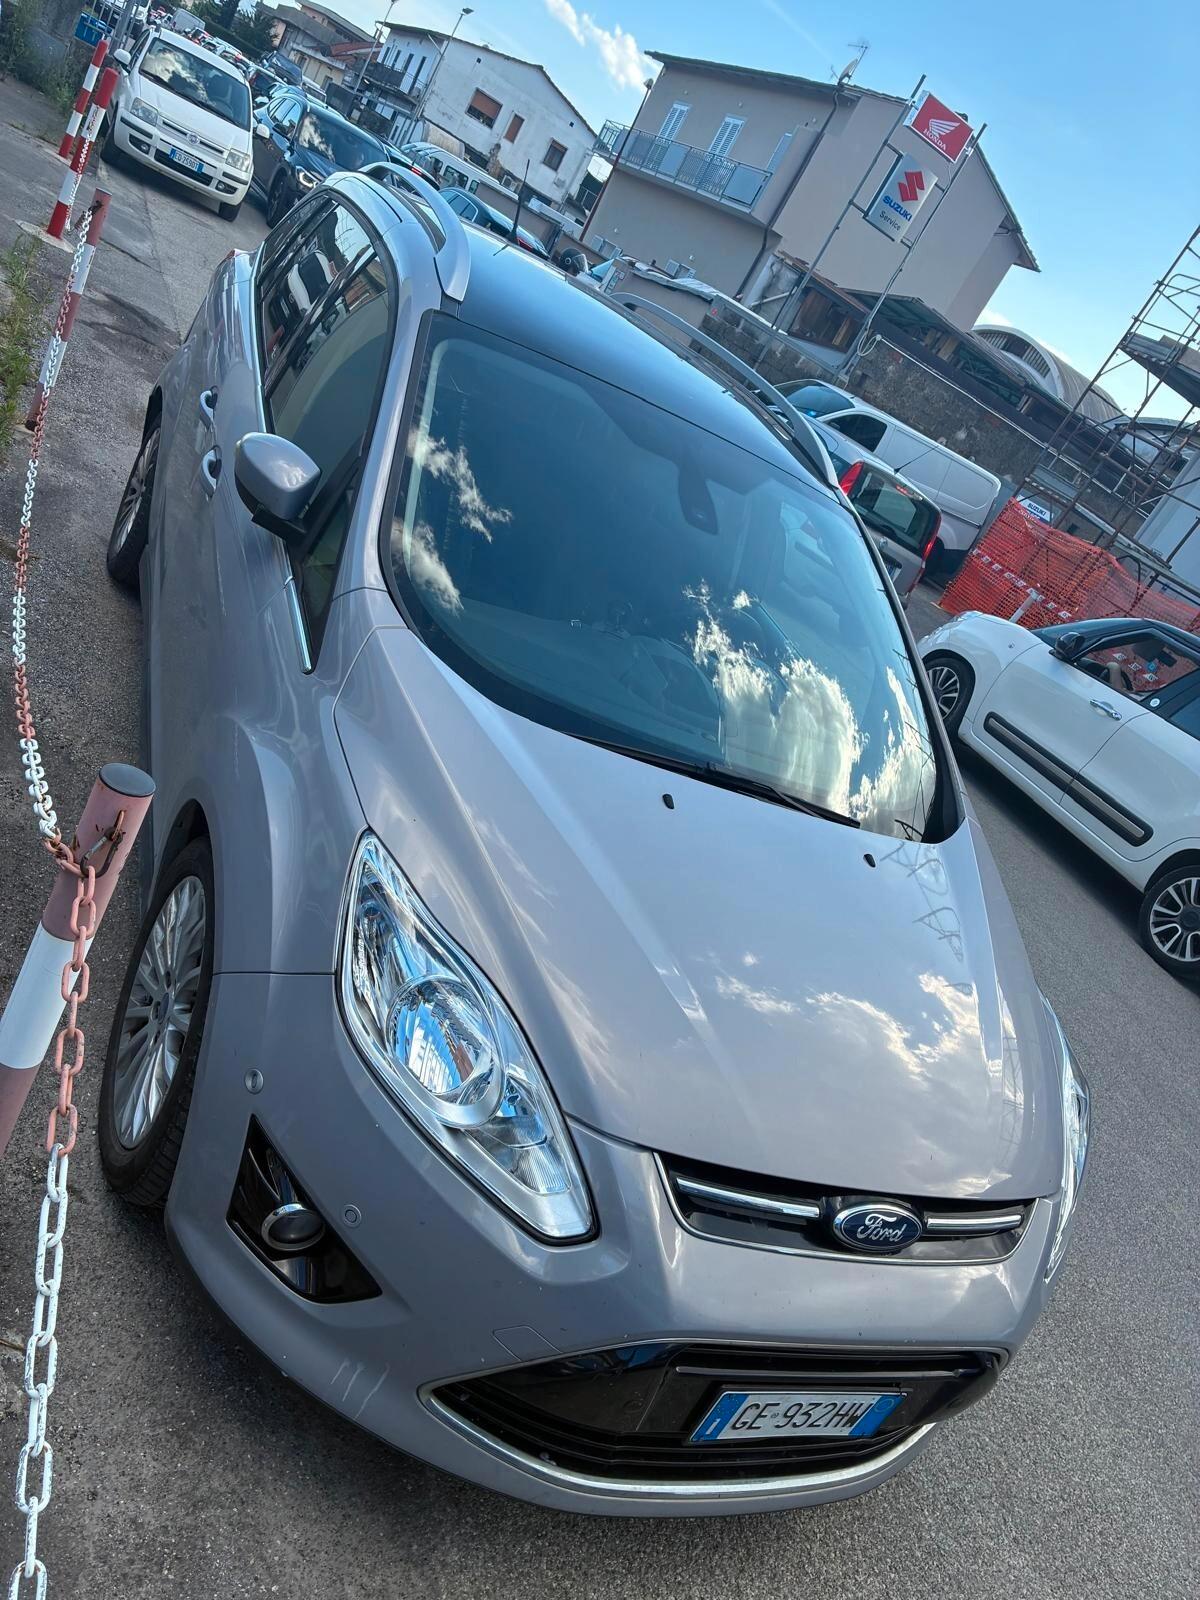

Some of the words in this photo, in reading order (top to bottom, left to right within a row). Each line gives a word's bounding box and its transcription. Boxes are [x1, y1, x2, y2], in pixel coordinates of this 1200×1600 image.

[922, 128, 947, 151] HONDA
[879, 210, 902, 231] Service
[882, 195, 913, 222] SUZUKI
[1027, 502, 1047, 517] SUZUKI
[856, 1213, 906, 1242] Ford
[731, 1402, 780, 1431] GE
[775, 1402, 875, 1429] 932HW
